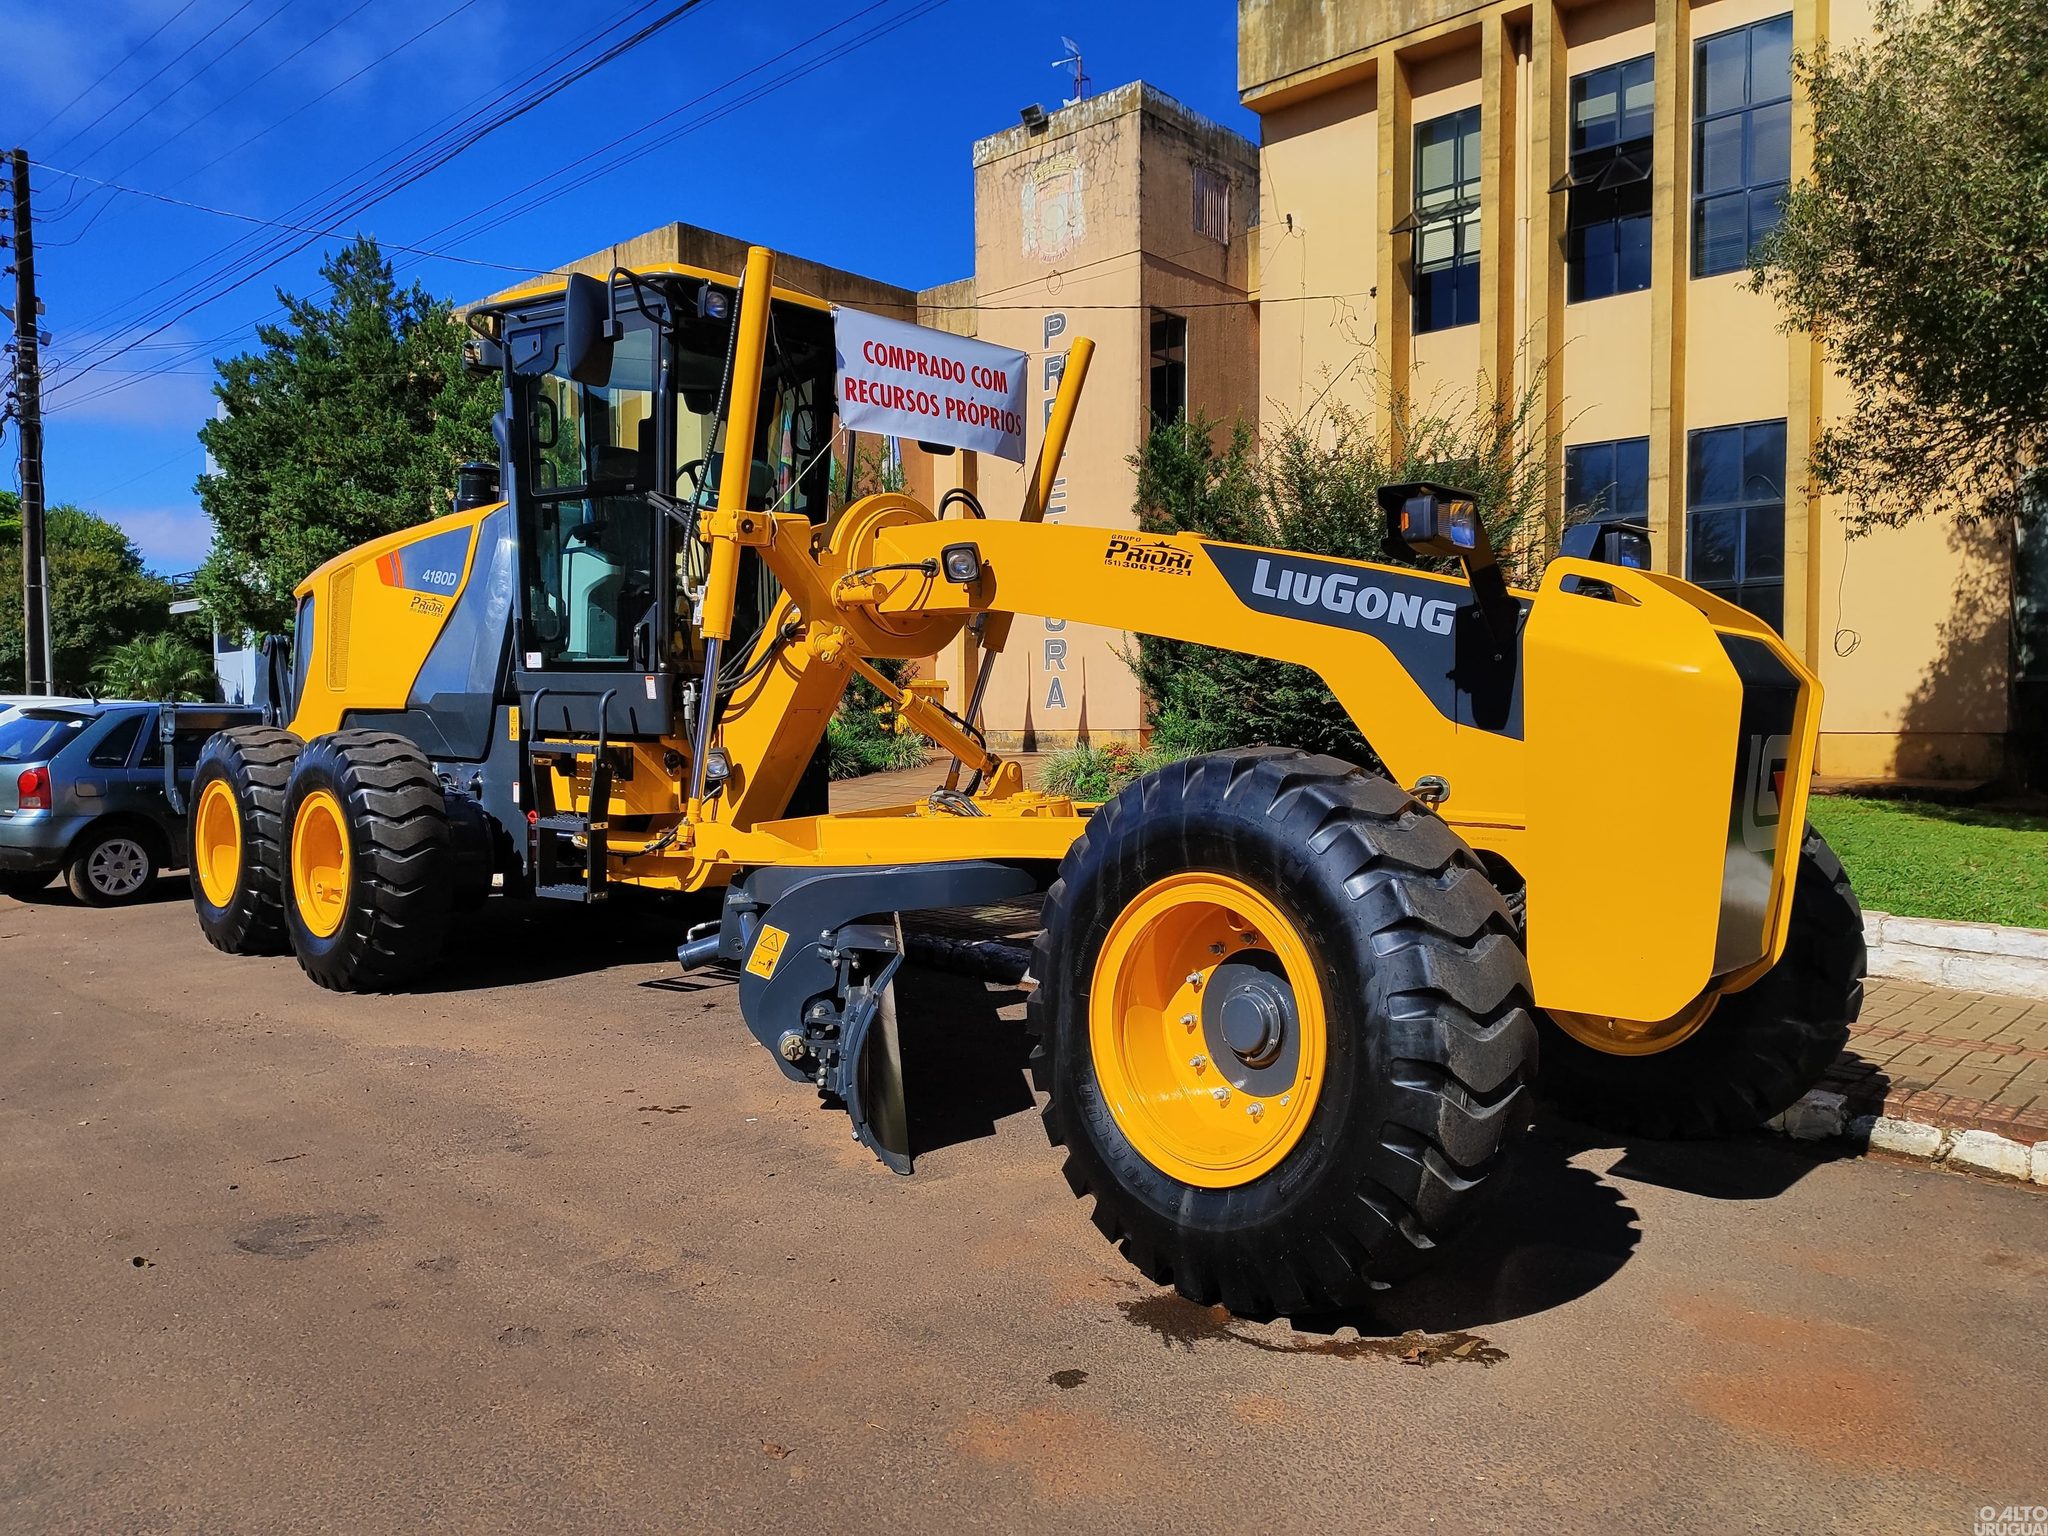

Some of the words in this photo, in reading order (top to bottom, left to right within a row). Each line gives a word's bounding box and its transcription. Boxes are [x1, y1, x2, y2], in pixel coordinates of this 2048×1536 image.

[863, 340, 966, 384] COMPRADO
[971, 365, 1008, 394] COM
[844, 377, 940, 417] RECURSOS
[944, 396, 1022, 437] PRÓPRIOS
[1111, 533, 1142, 543] GRUPO
[1104, 558, 1121, 567] (51)
[1122, 560, 1192, 577] 3061-2221
[422, 569, 457, 586] 4180D
